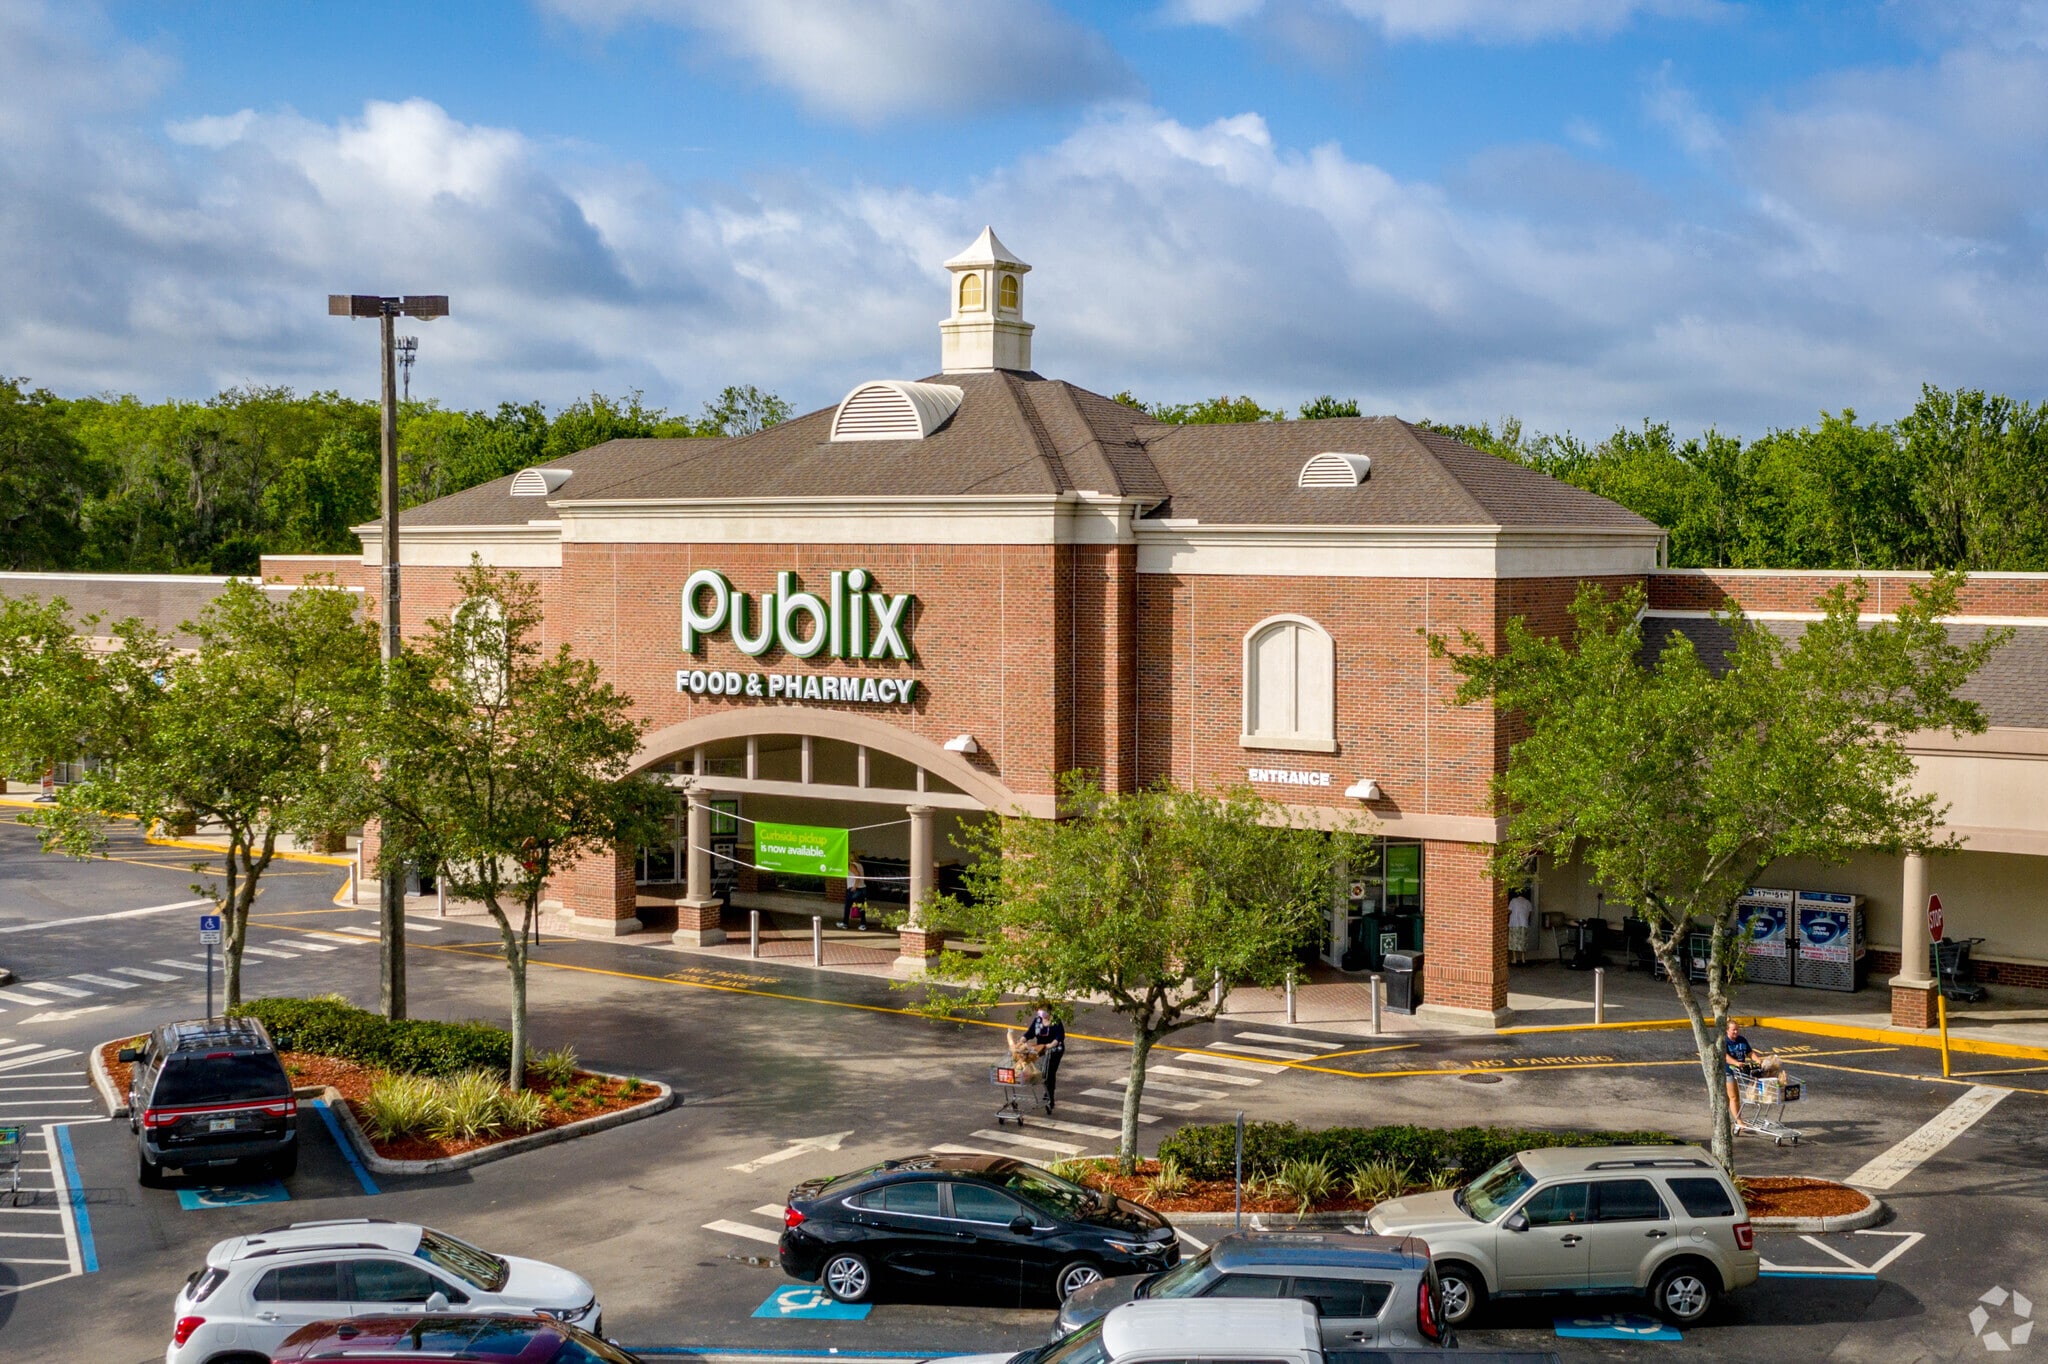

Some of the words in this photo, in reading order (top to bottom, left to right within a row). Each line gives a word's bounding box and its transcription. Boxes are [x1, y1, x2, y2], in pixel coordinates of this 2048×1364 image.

[681, 568, 913, 660] Publix
[676, 670, 743, 696] FOOD
[746, 673, 763, 698] &
[768, 674, 915, 704] PHARMACY
[1248, 768, 1330, 787] ENTRANCE
[760, 828, 798, 842] Curbside
[799, 832, 828, 847] pickup
[760, 841, 767, 852] is
[767, 843, 786, 854] now
[787, 844, 826, 858] available.
[1929, 909, 1942, 929] STOP
[1472, 1059, 1505, 1069] NO
[1513, 1055, 1614, 1066] PARKING
